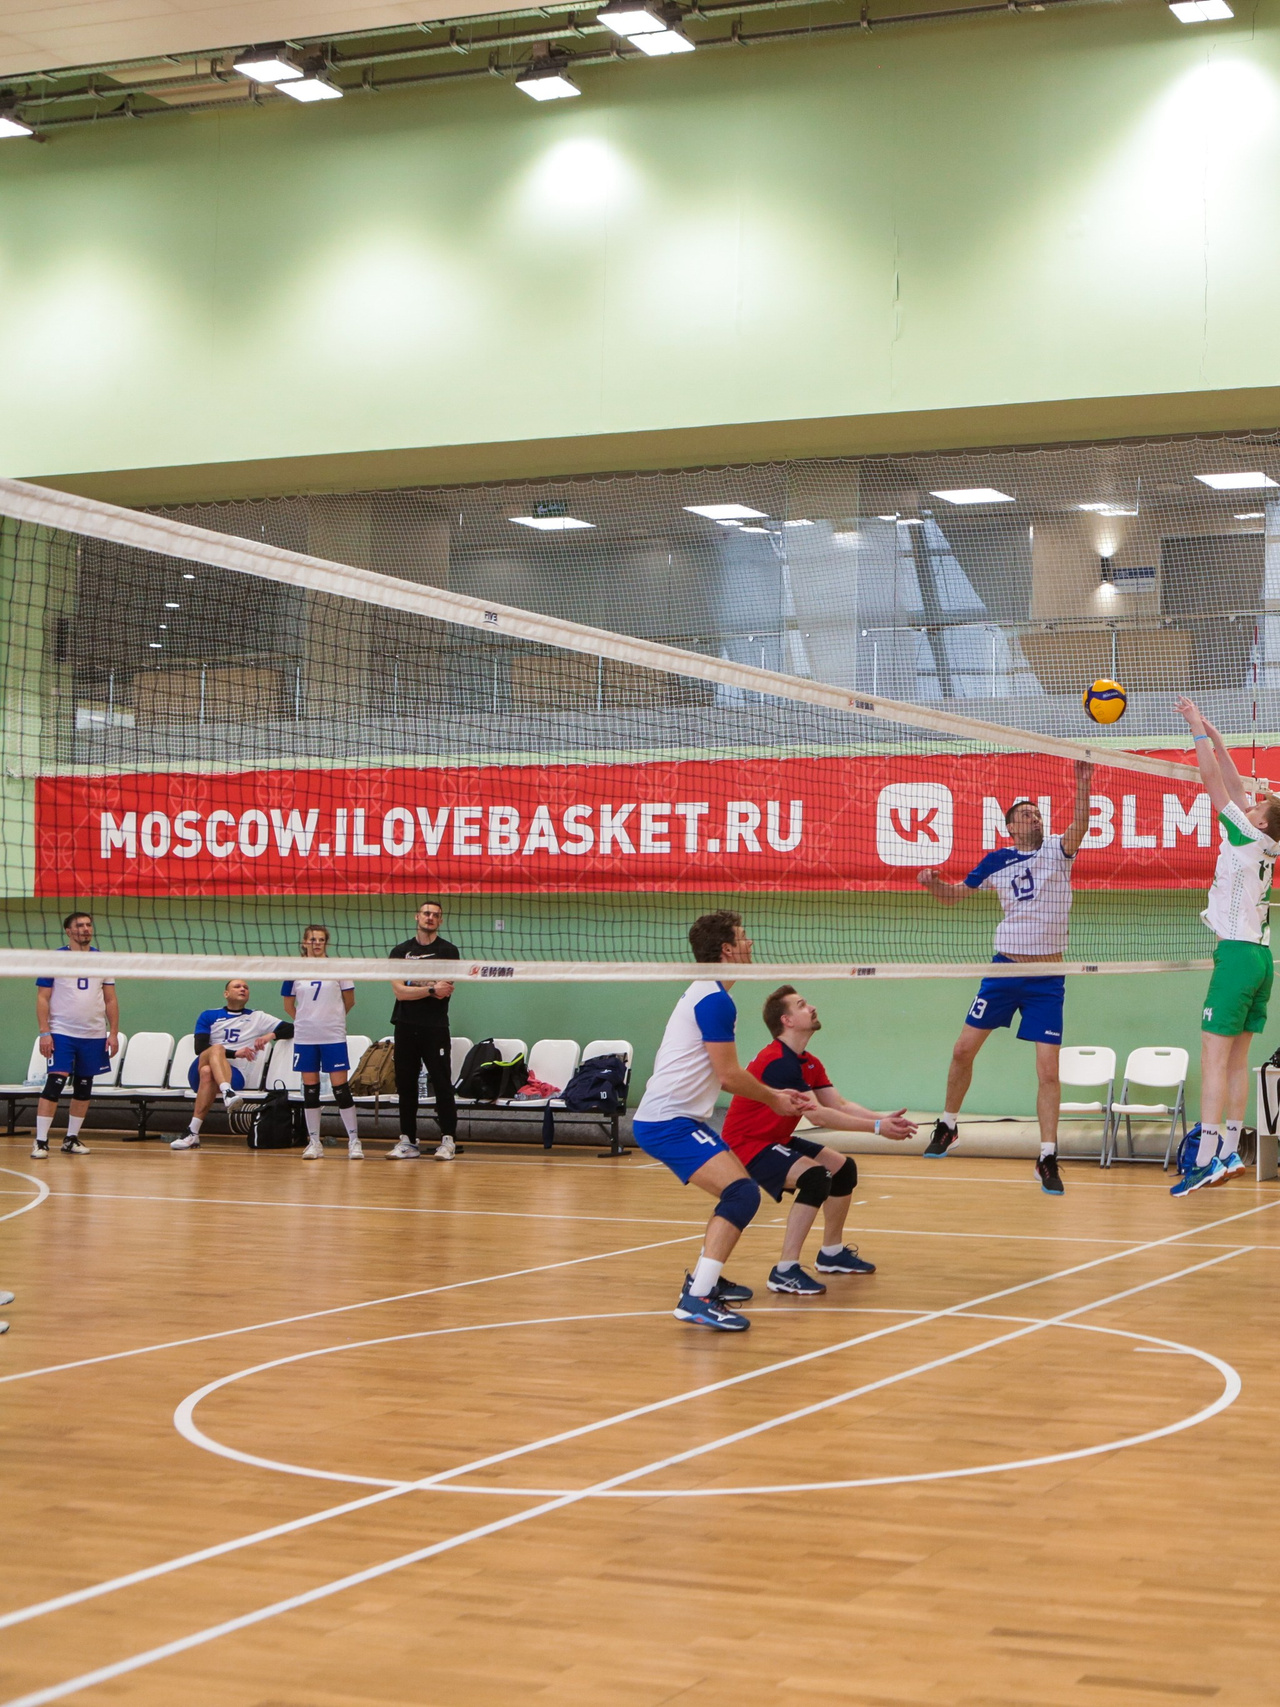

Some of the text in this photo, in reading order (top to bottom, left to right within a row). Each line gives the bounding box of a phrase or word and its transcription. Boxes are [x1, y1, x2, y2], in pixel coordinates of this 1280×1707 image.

[100, 800, 803, 859] MOSCOW.ILOVEBASKET.RU
[310, 980, 322, 1001] 7
[968, 995, 988, 1019] 13
[1202, 1007, 1213, 1022] 14
[223, 1028, 241, 1043] 15
[293, 1053, 300, 1068] 7
[600, 1091, 607, 1100] 10
[691, 1129, 717, 1147] 4
